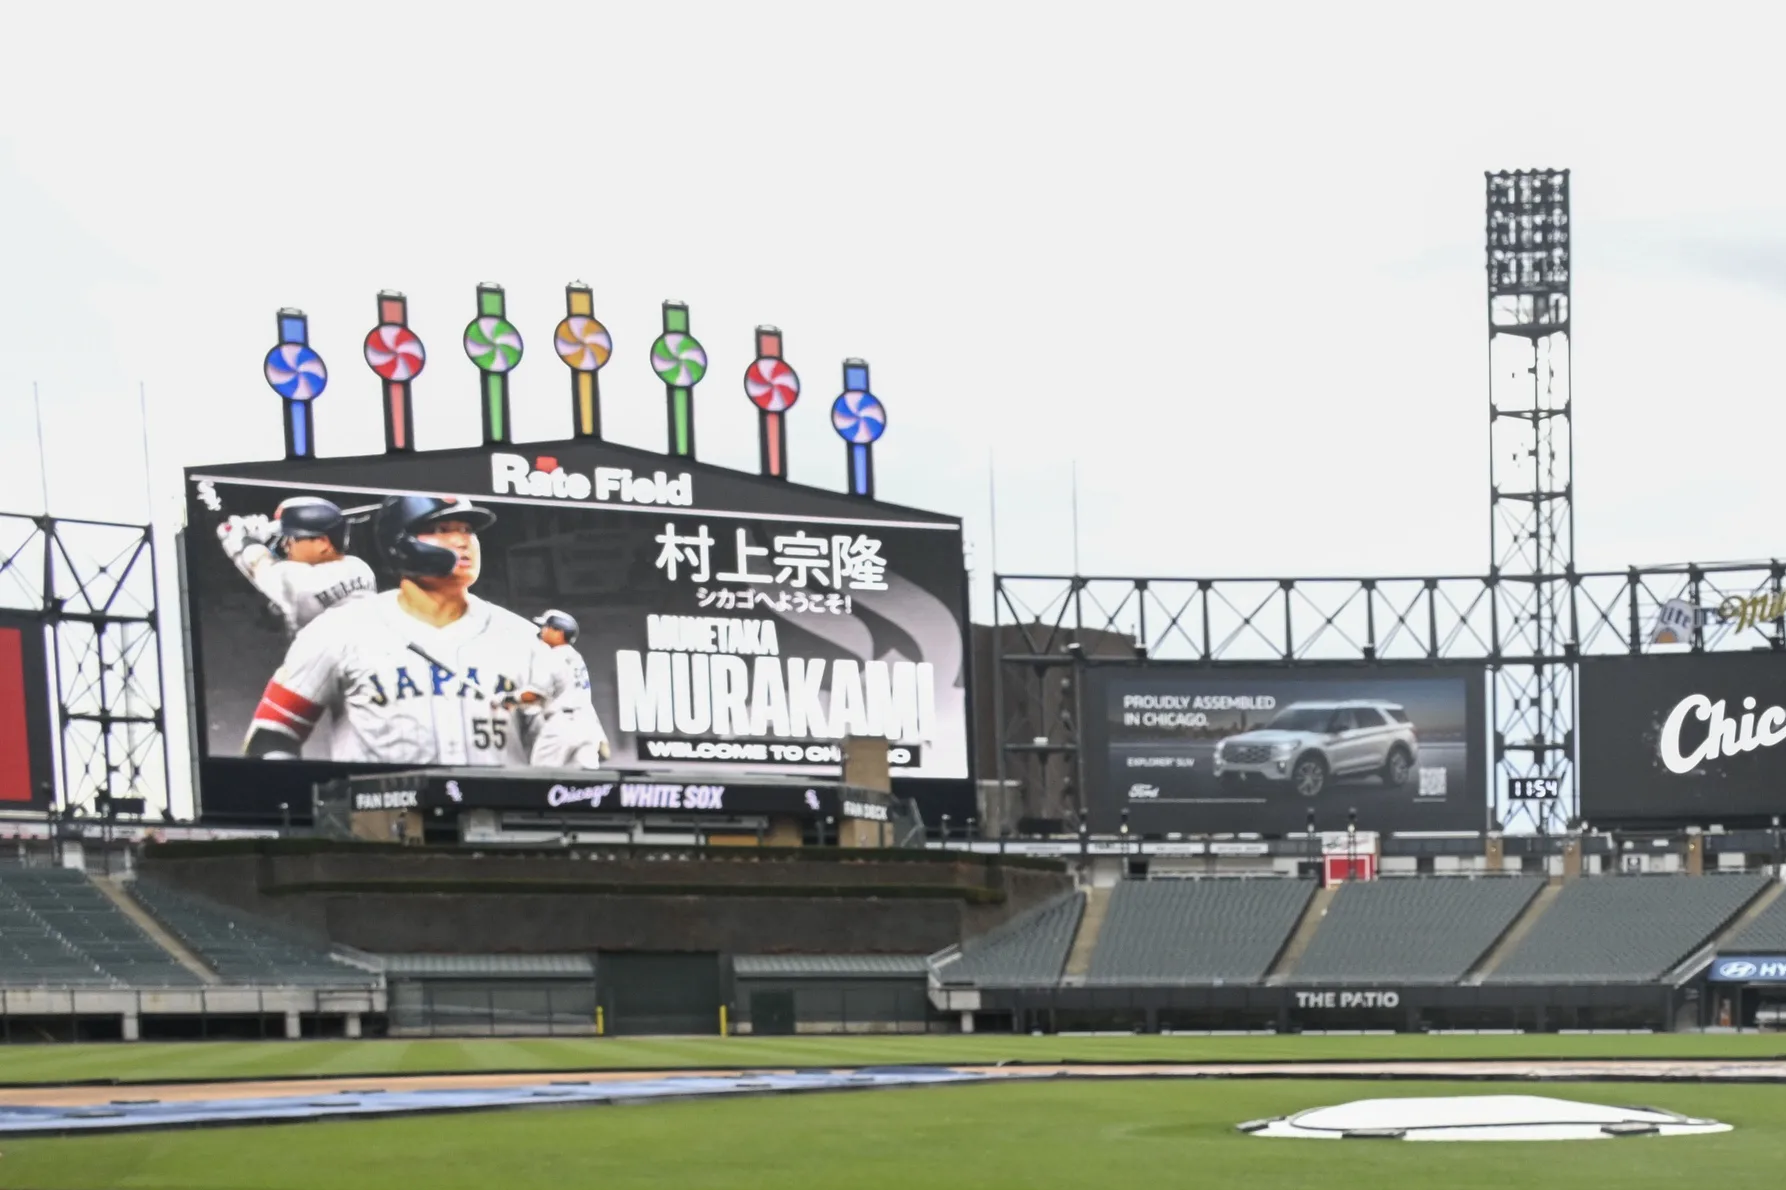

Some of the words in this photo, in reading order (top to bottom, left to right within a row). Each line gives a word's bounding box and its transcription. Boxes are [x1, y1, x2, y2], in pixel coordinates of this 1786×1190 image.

[491, 453, 592, 499] Rate
[595, 467, 693, 506] Field
[655, 522, 888, 590] 村上宗隆
[1660, 605, 1692, 628] Lite
[647, 614, 779, 655] MUNETAKA
[616, 650, 936, 740] MURAKAMI
[1123, 695, 1191, 710] PROUDLY
[1192, 695, 1277, 710] ASSEMBLED
[1123, 712, 1141, 727] IN
[472, 718, 508, 750] 55
[647, 741, 768, 761] WELCOME
[769, 745, 803, 761] TO
[356, 793, 381, 810] FAN
[383, 790, 417, 809] DECK
[620, 784, 682, 808] WHITE
[684, 785, 724, 809] SOX
[1295, 991, 1336, 1008] THE
[1340, 991, 1400, 1008] PATIO
